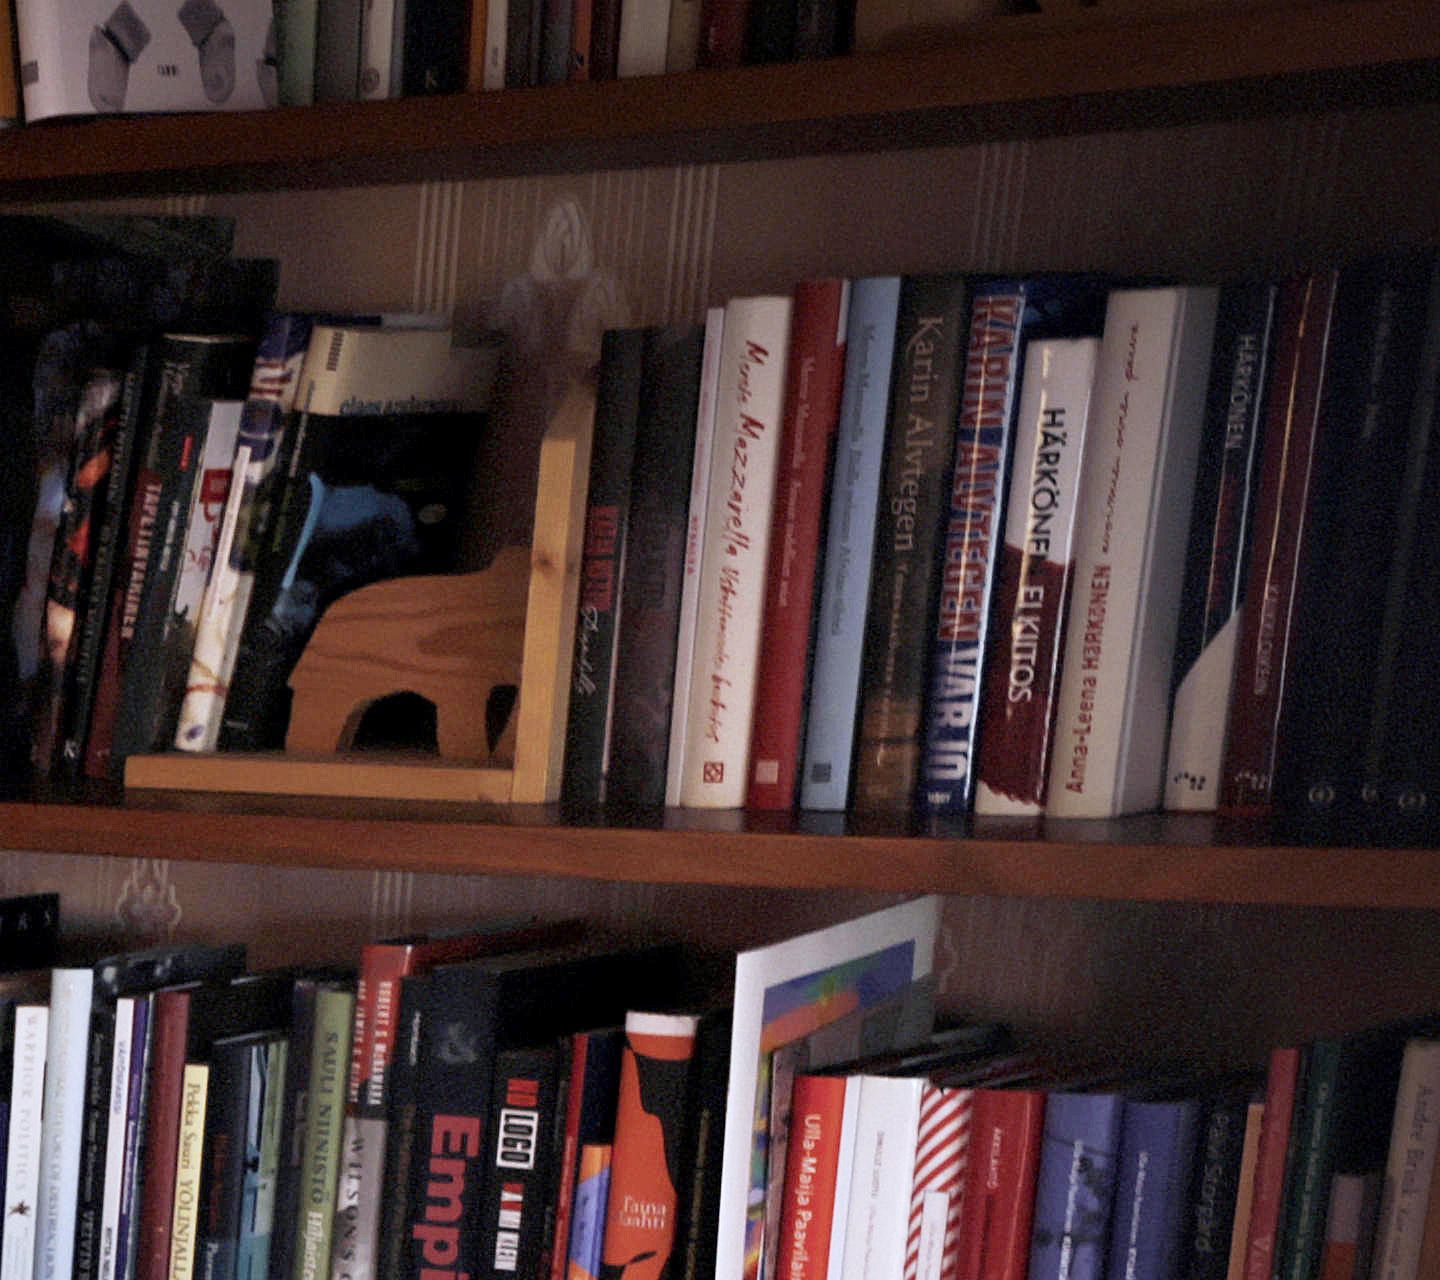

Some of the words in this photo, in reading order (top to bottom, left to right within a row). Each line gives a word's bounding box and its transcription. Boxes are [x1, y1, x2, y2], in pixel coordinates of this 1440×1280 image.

[903, 315, 942, 404] Karin
[963, 295, 1019, 424] KARIN
[893, 414, 935, 551] Alvtegen
[940, 445, 1002, 642] ALVTEGEN
[1066, 674, 1098, 793] Anna-Leena
[187, 1082, 201, 1127] Pekka
[323, 1031, 341, 1094] SAULI
[311, 1102, 336, 1205] NIINISTÖ
[501, 1113, 535, 1163] LOGO
[799, 1113, 823, 1203] Ulla-Maija
[338, 1135, 365, 1263] WILSON'S
